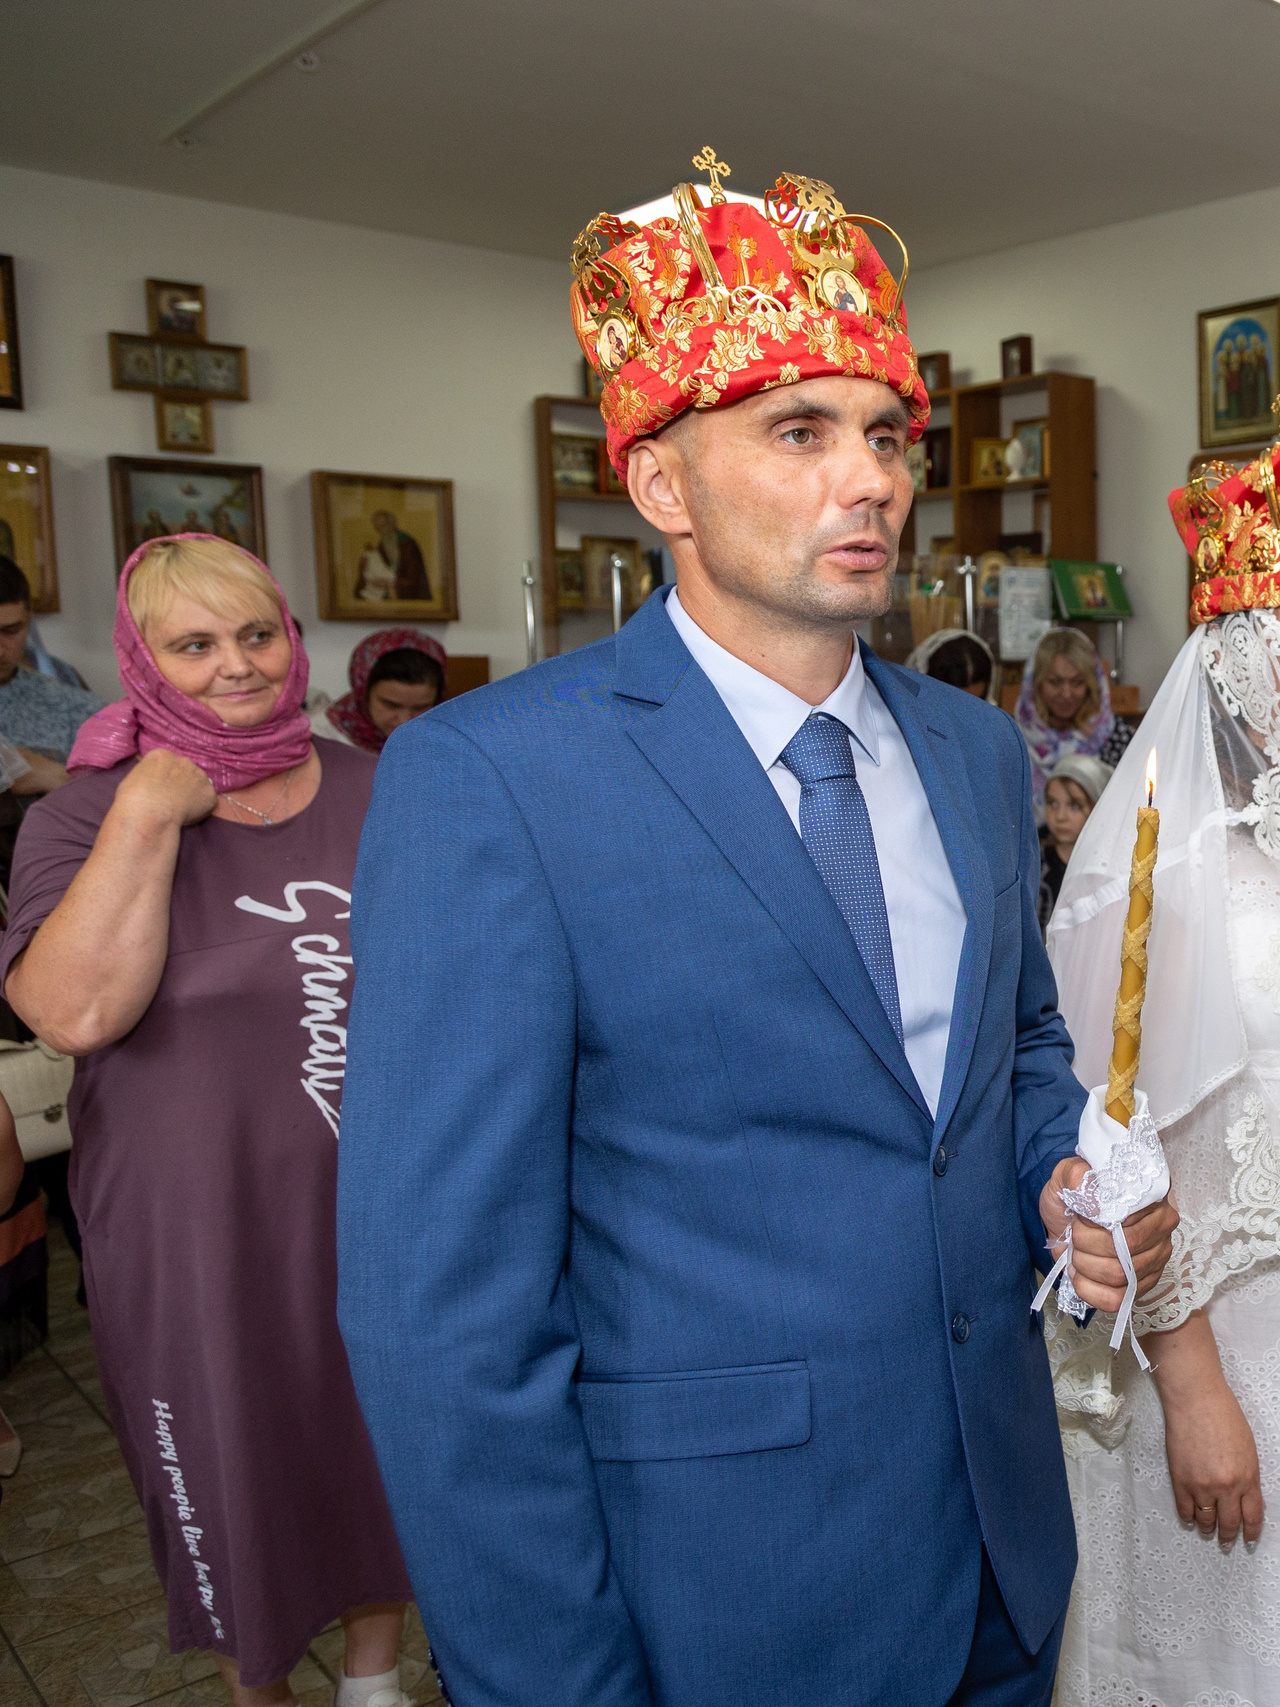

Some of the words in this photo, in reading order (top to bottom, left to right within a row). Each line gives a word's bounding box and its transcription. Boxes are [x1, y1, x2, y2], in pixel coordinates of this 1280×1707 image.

[152, 1398, 179, 1462] Happy
[181, 1525, 203, 1556] live
[193, 1560, 214, 1611] happy
